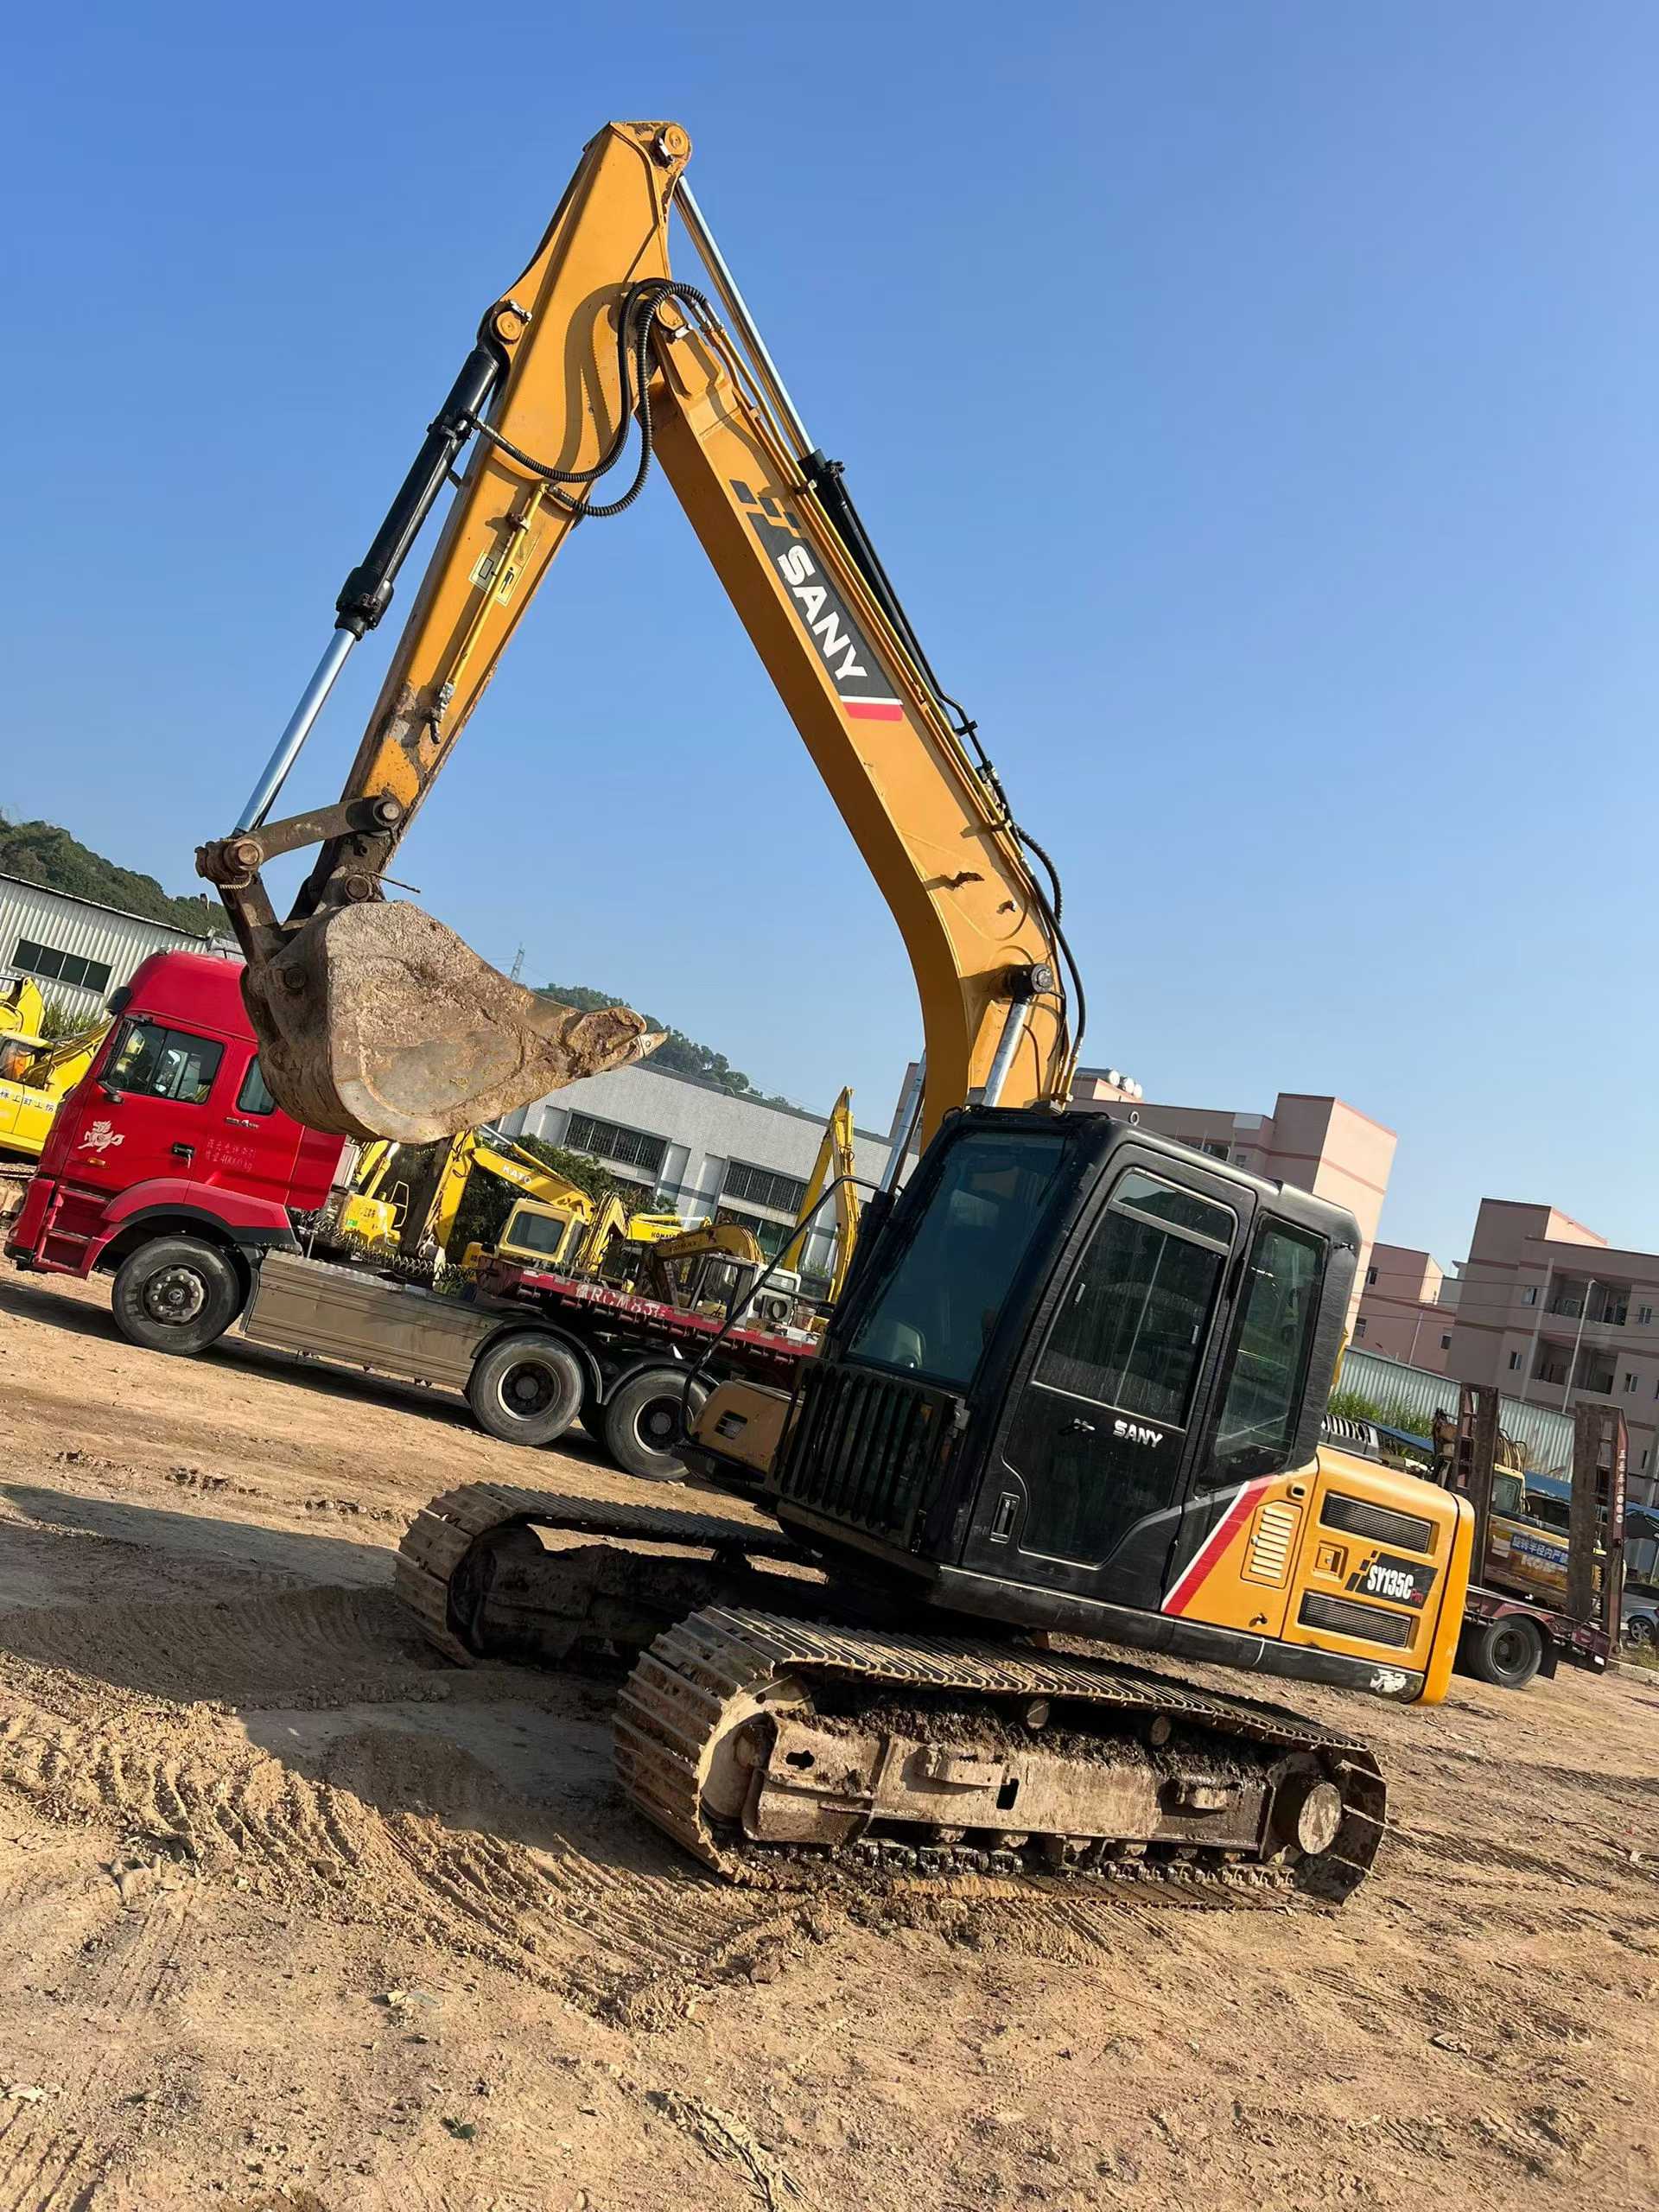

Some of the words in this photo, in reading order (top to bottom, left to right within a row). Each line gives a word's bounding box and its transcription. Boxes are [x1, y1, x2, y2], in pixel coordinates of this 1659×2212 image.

[778, 544, 868, 680] SANY
[503, 1164, 532, 1185] KATO
[1113, 1419, 1163, 1448] SANY
[1367, 1564, 1414, 1600] SY135C
